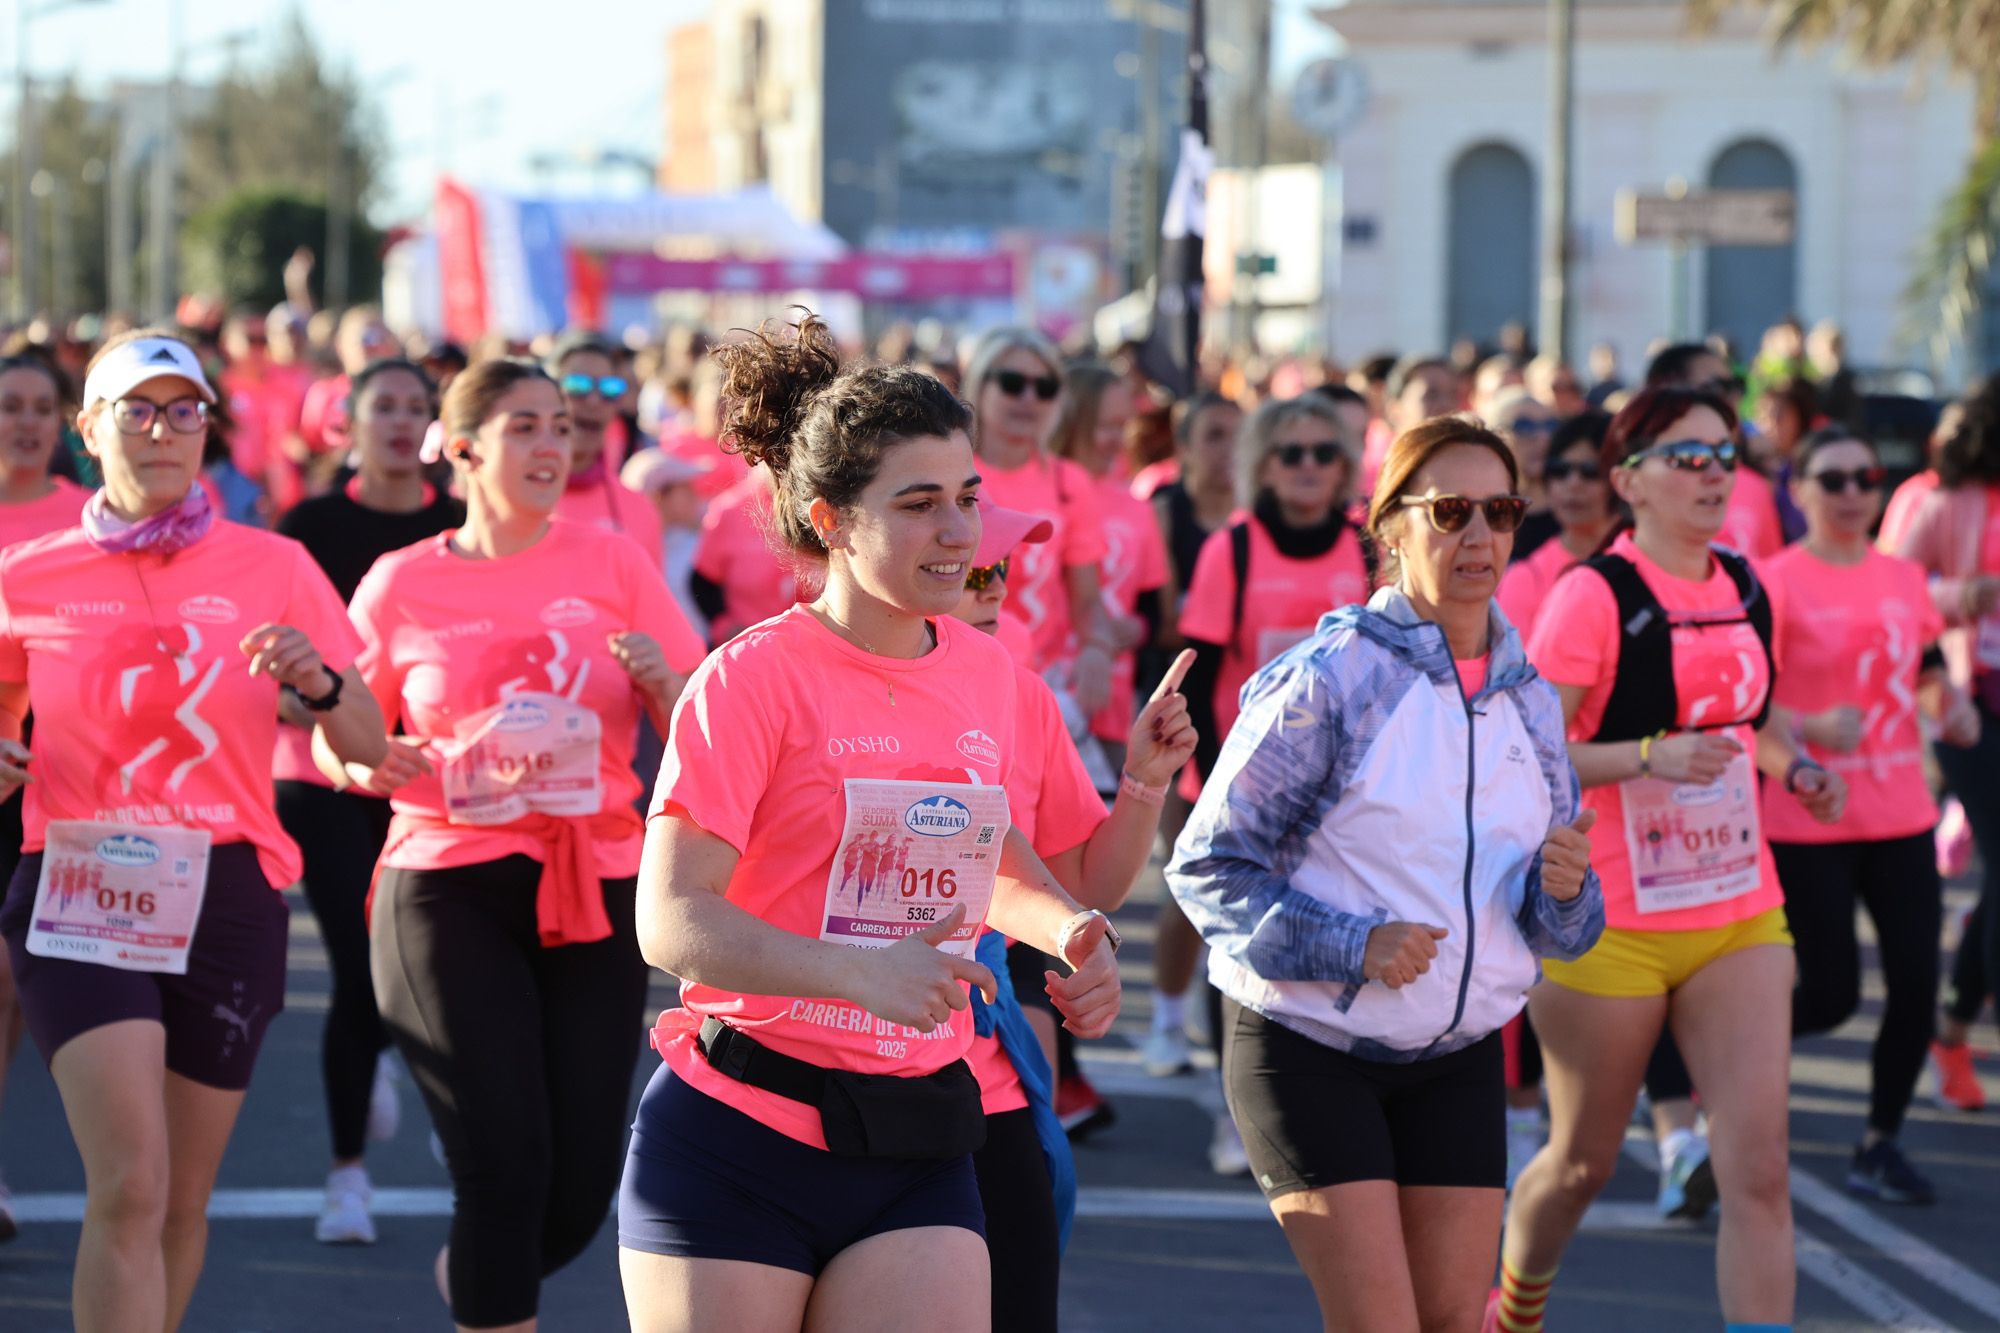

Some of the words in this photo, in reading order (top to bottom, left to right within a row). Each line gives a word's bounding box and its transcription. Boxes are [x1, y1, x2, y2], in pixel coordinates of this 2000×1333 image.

[828, 735, 900, 757] OYSHO
[861, 815, 897, 827] SUMA
[910, 809, 966, 828] ASTURIANA
[1683, 824, 1731, 852] 016
[900, 867, 957, 899] 016
[96, 888, 156, 916] 016
[906, 907, 936, 921] 5362
[851, 922, 891, 936] CARRERA
[892, 925, 903, 936] DE
[904, 926, 915, 936] LA
[46, 938, 99, 954] OYSHO
[789, 999, 872, 1034] CARRERA
[876, 1017, 897, 1037] DE
[875, 1039, 907, 1060] 2025
